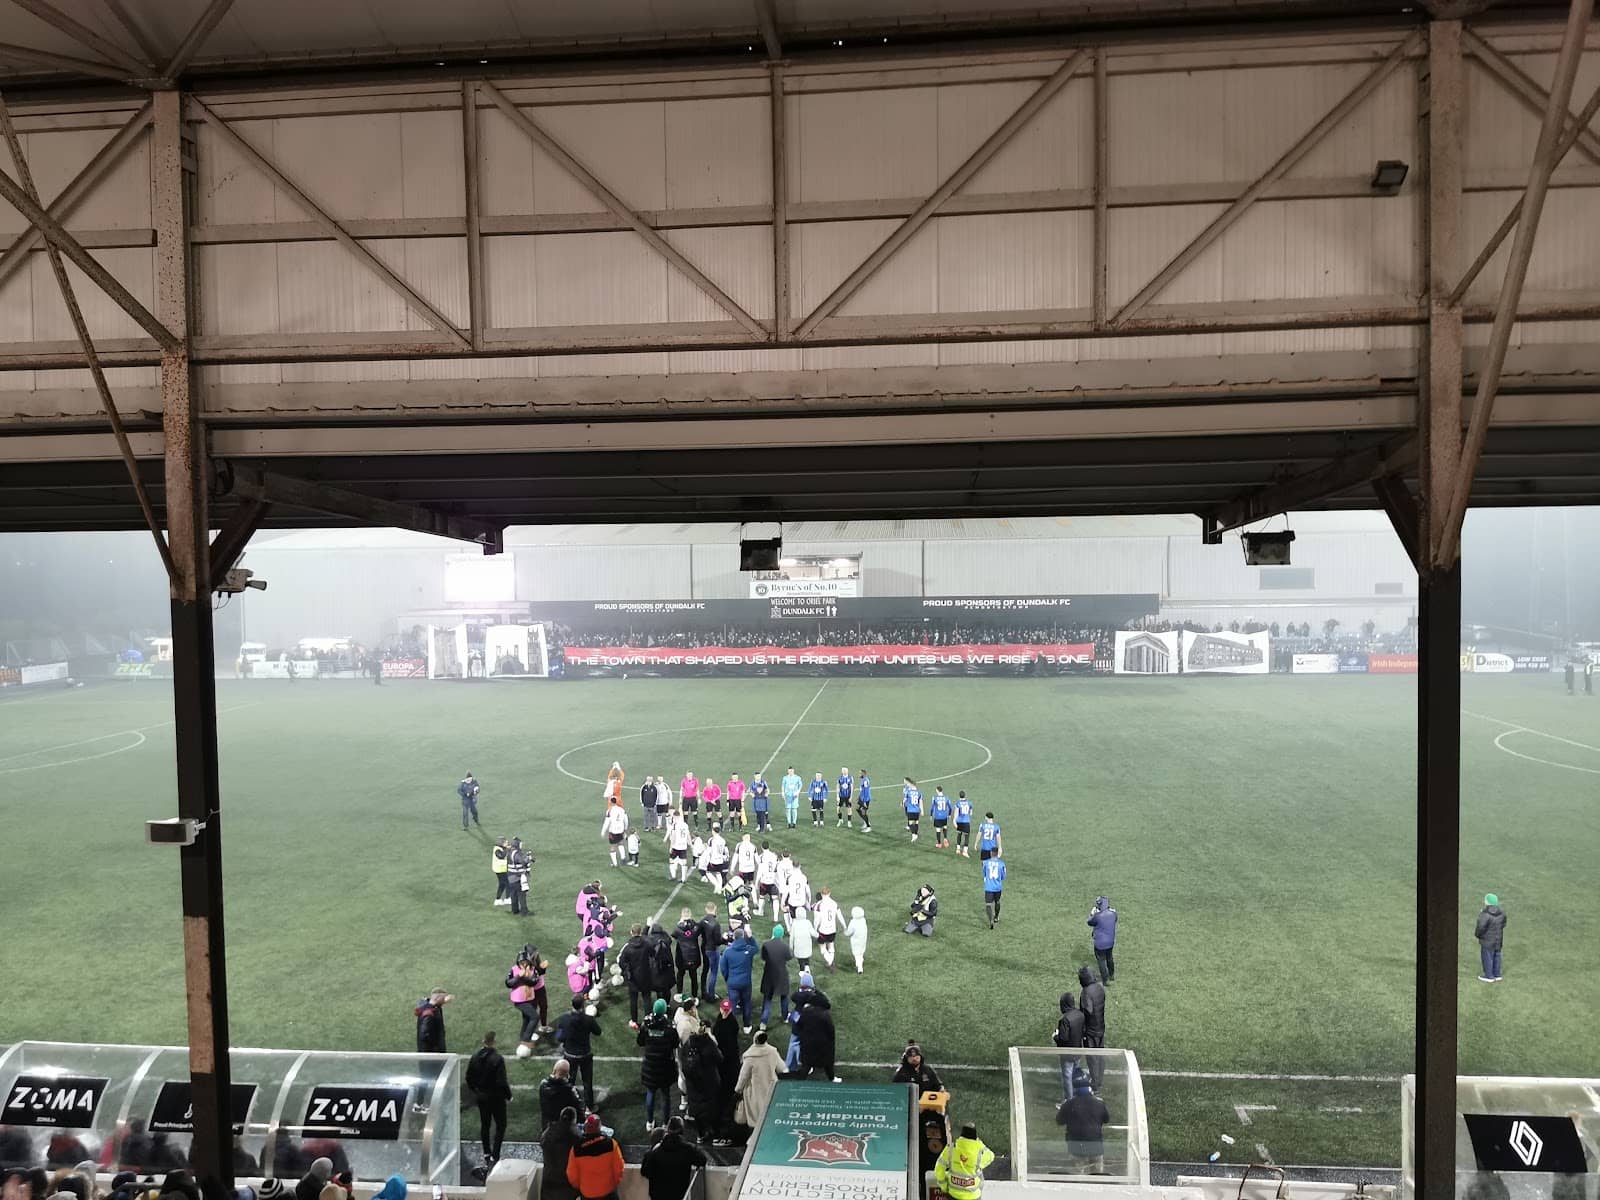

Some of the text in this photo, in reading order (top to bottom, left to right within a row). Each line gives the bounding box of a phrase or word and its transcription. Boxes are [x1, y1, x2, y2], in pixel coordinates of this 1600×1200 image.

[771, 583, 802, 592] Byrne's
[803, 583, 812, 591] of
[568, 656, 599, 665] THE
[603, 656, 646, 665] TOWN
[649, 656, 684, 665] THAT
[685, 655, 742, 665] SHAPED
[768, 656, 796, 665] THE
[800, 655, 839, 664] PRIDE
[842, 655, 880, 664] THAT
[884, 655, 937, 664] UNITES
[968, 655, 994, 664] WE
[999, 655, 1031, 664] RISE
[984, 829, 994, 840] 21
[8, 1087, 93, 1111] ZOMA
[309, 1098, 397, 1122] ZOMA
[788, 1111, 886, 1122] Dundalk FC
[774, 1118, 899, 1130] Proudly Supporting
[753, 1179, 875, 1193] PROSPERITY
